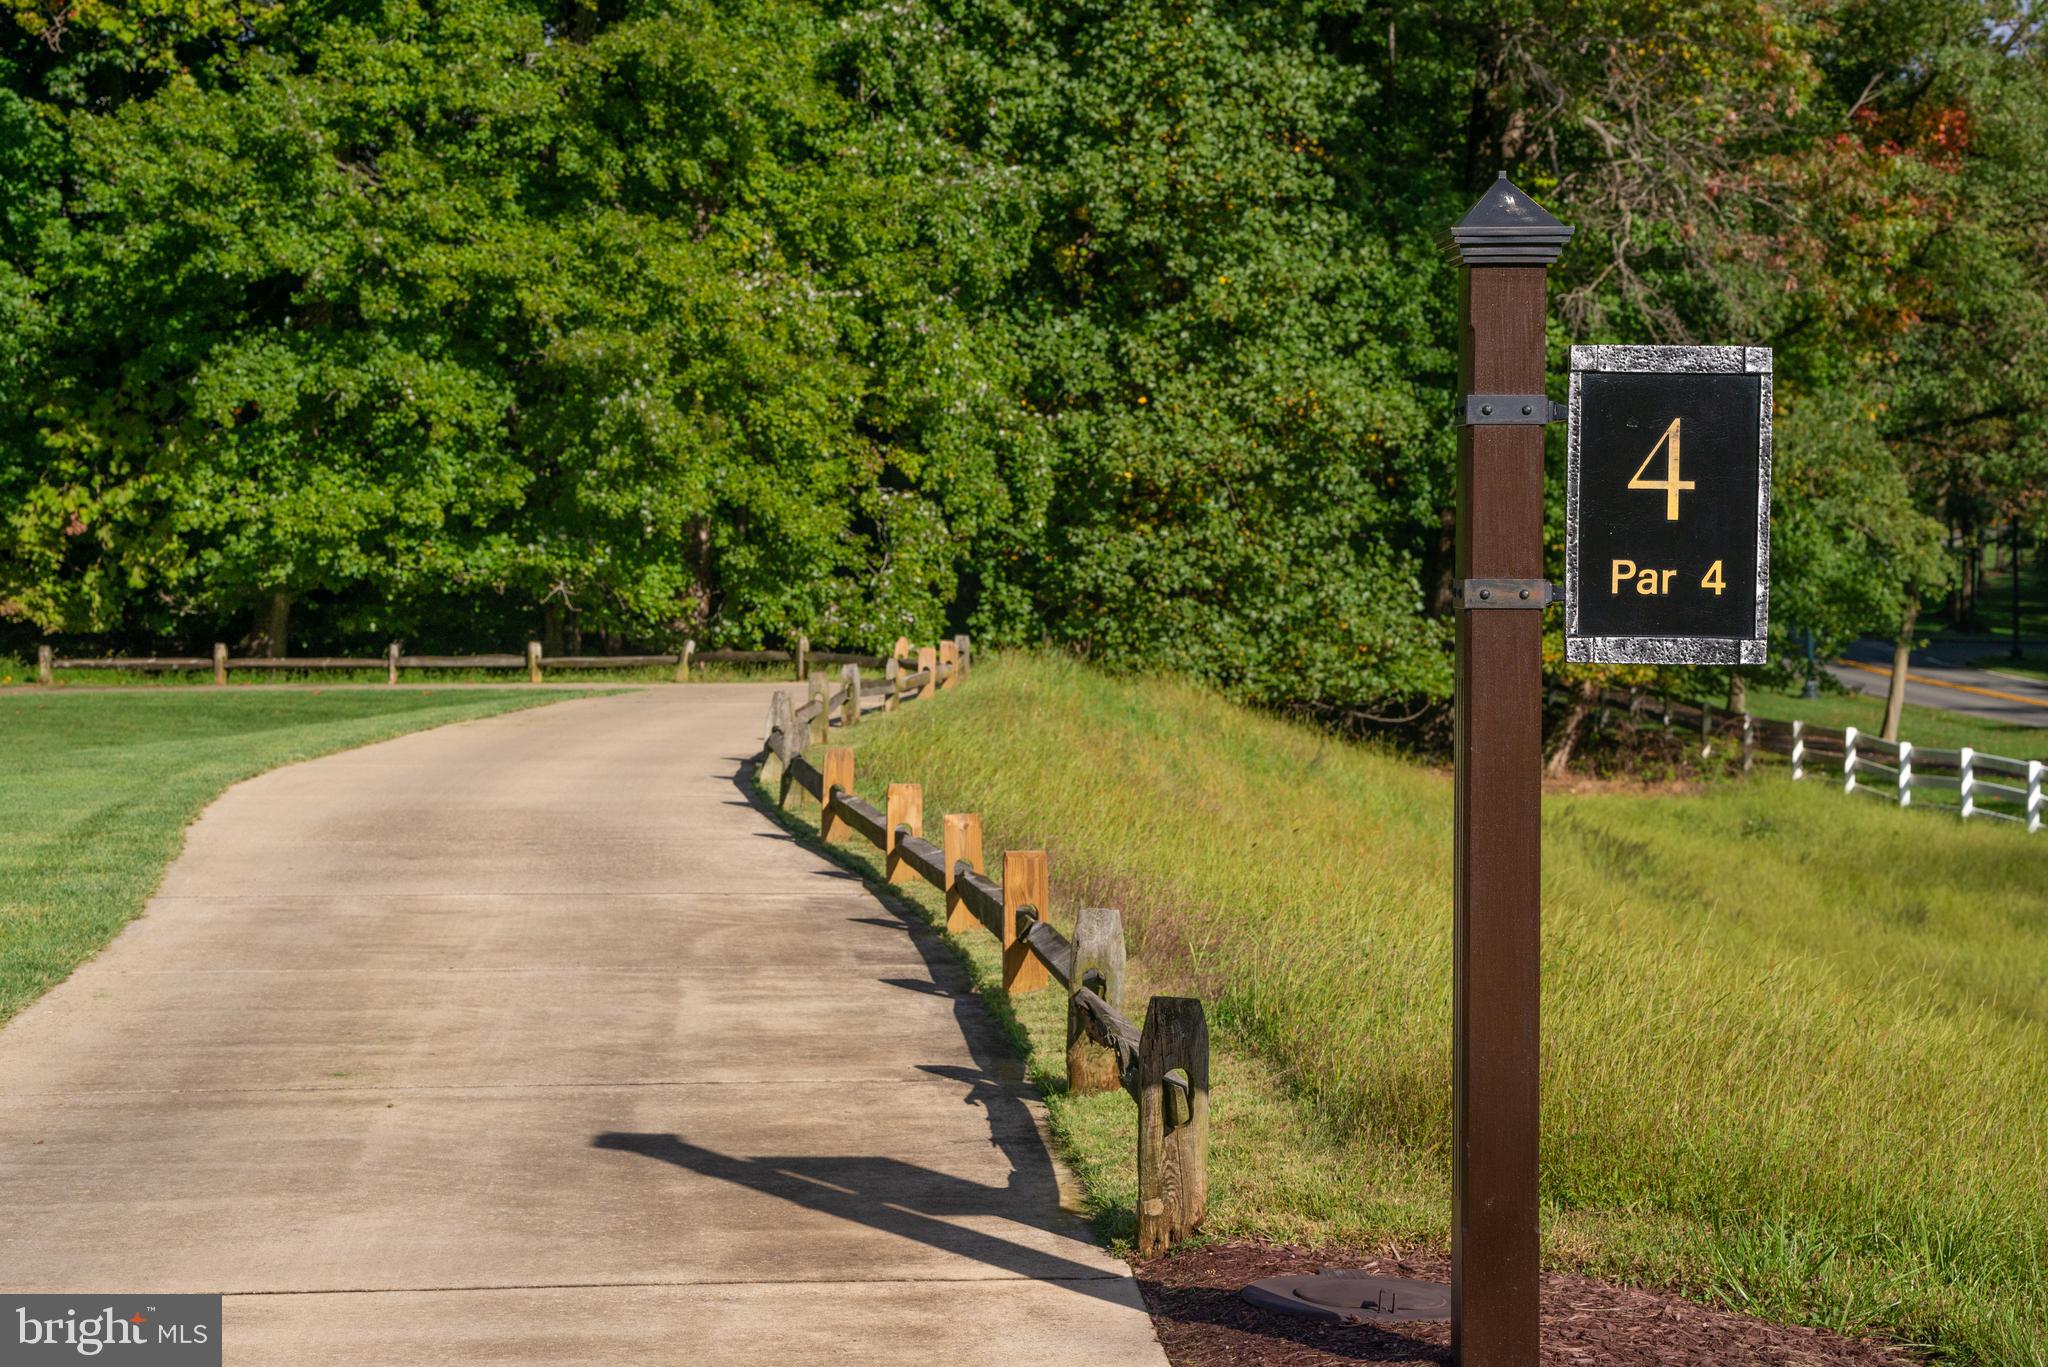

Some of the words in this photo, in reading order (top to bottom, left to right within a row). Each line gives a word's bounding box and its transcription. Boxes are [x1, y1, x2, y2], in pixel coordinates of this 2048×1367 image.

[1627, 417, 1696, 521] 4
[1611, 559, 1677, 596] Par
[1700, 559, 1727, 596] 4
